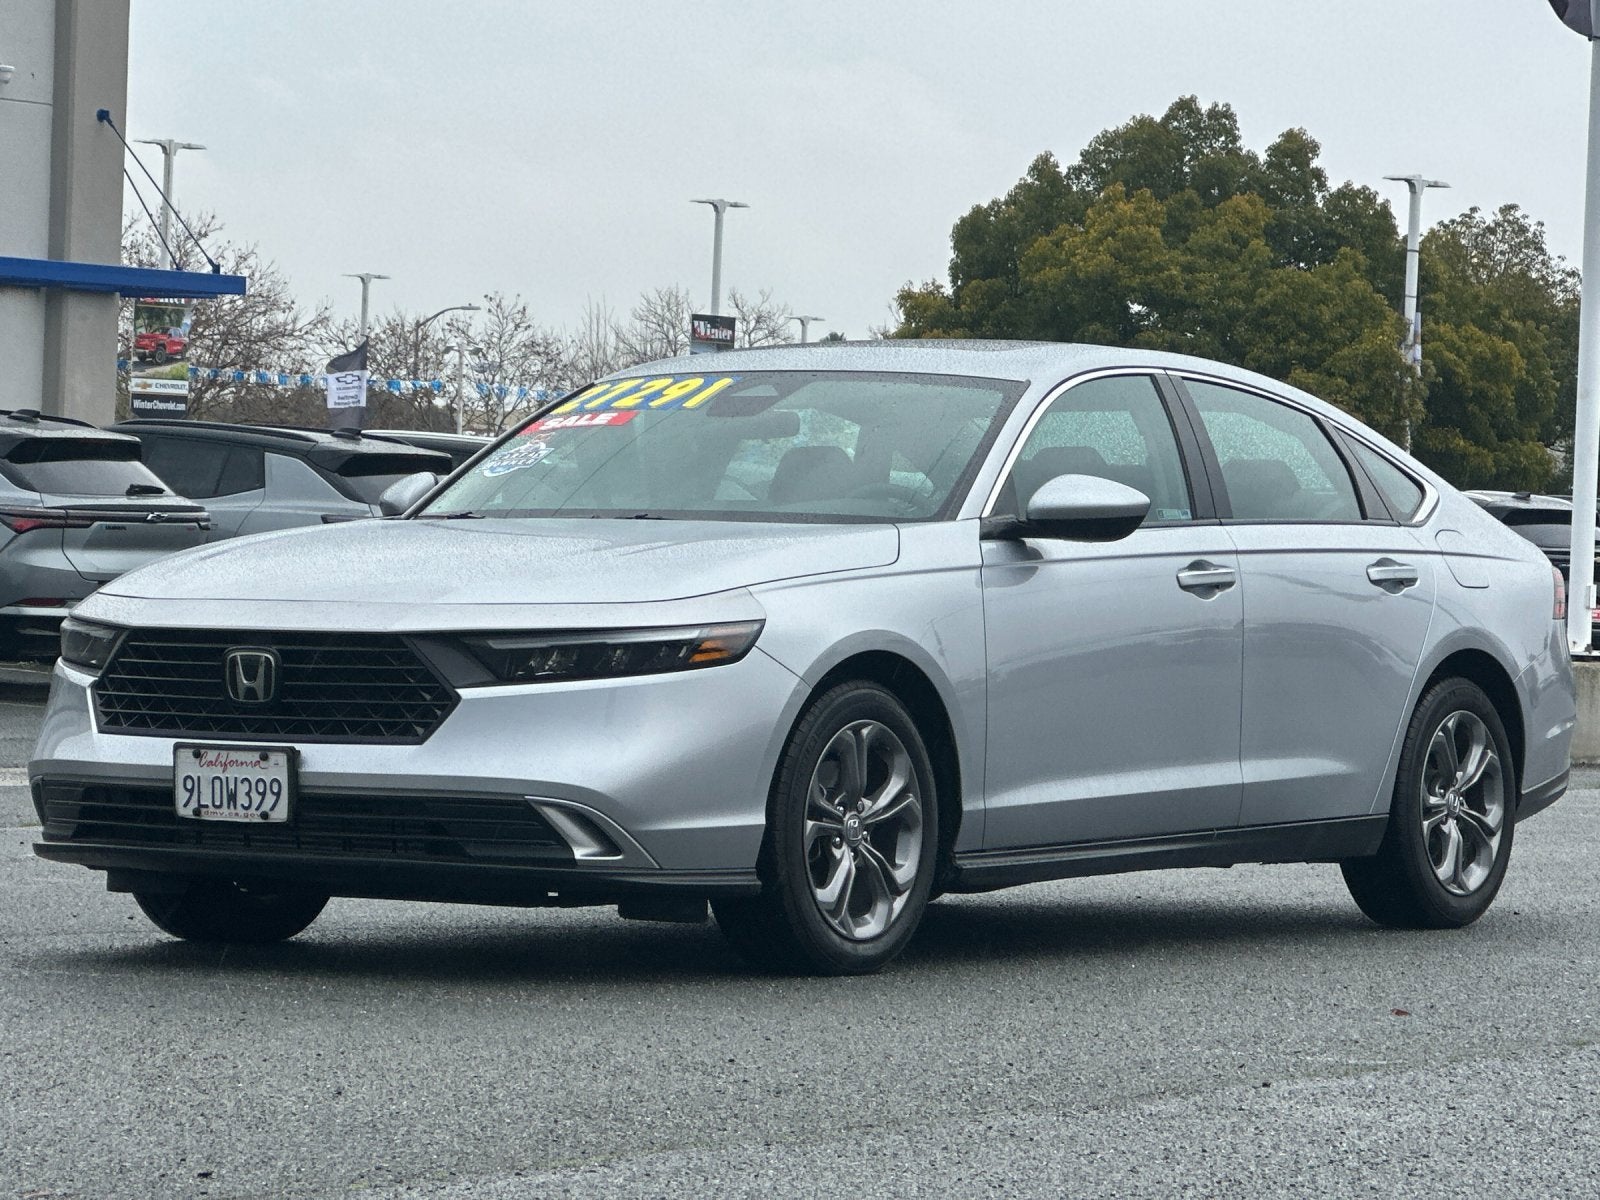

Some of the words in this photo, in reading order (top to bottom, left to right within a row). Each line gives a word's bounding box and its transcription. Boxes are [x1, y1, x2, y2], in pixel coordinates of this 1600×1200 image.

[694, 320, 732, 340] Winter
[133, 399, 186, 411] WinterChevrolet.com
[539, 412, 618, 431] SALE
[199, 751, 269, 774] California
[182, 774, 282, 812] 9LOW399
[203, 810, 261, 819] dmv.ca.gov
